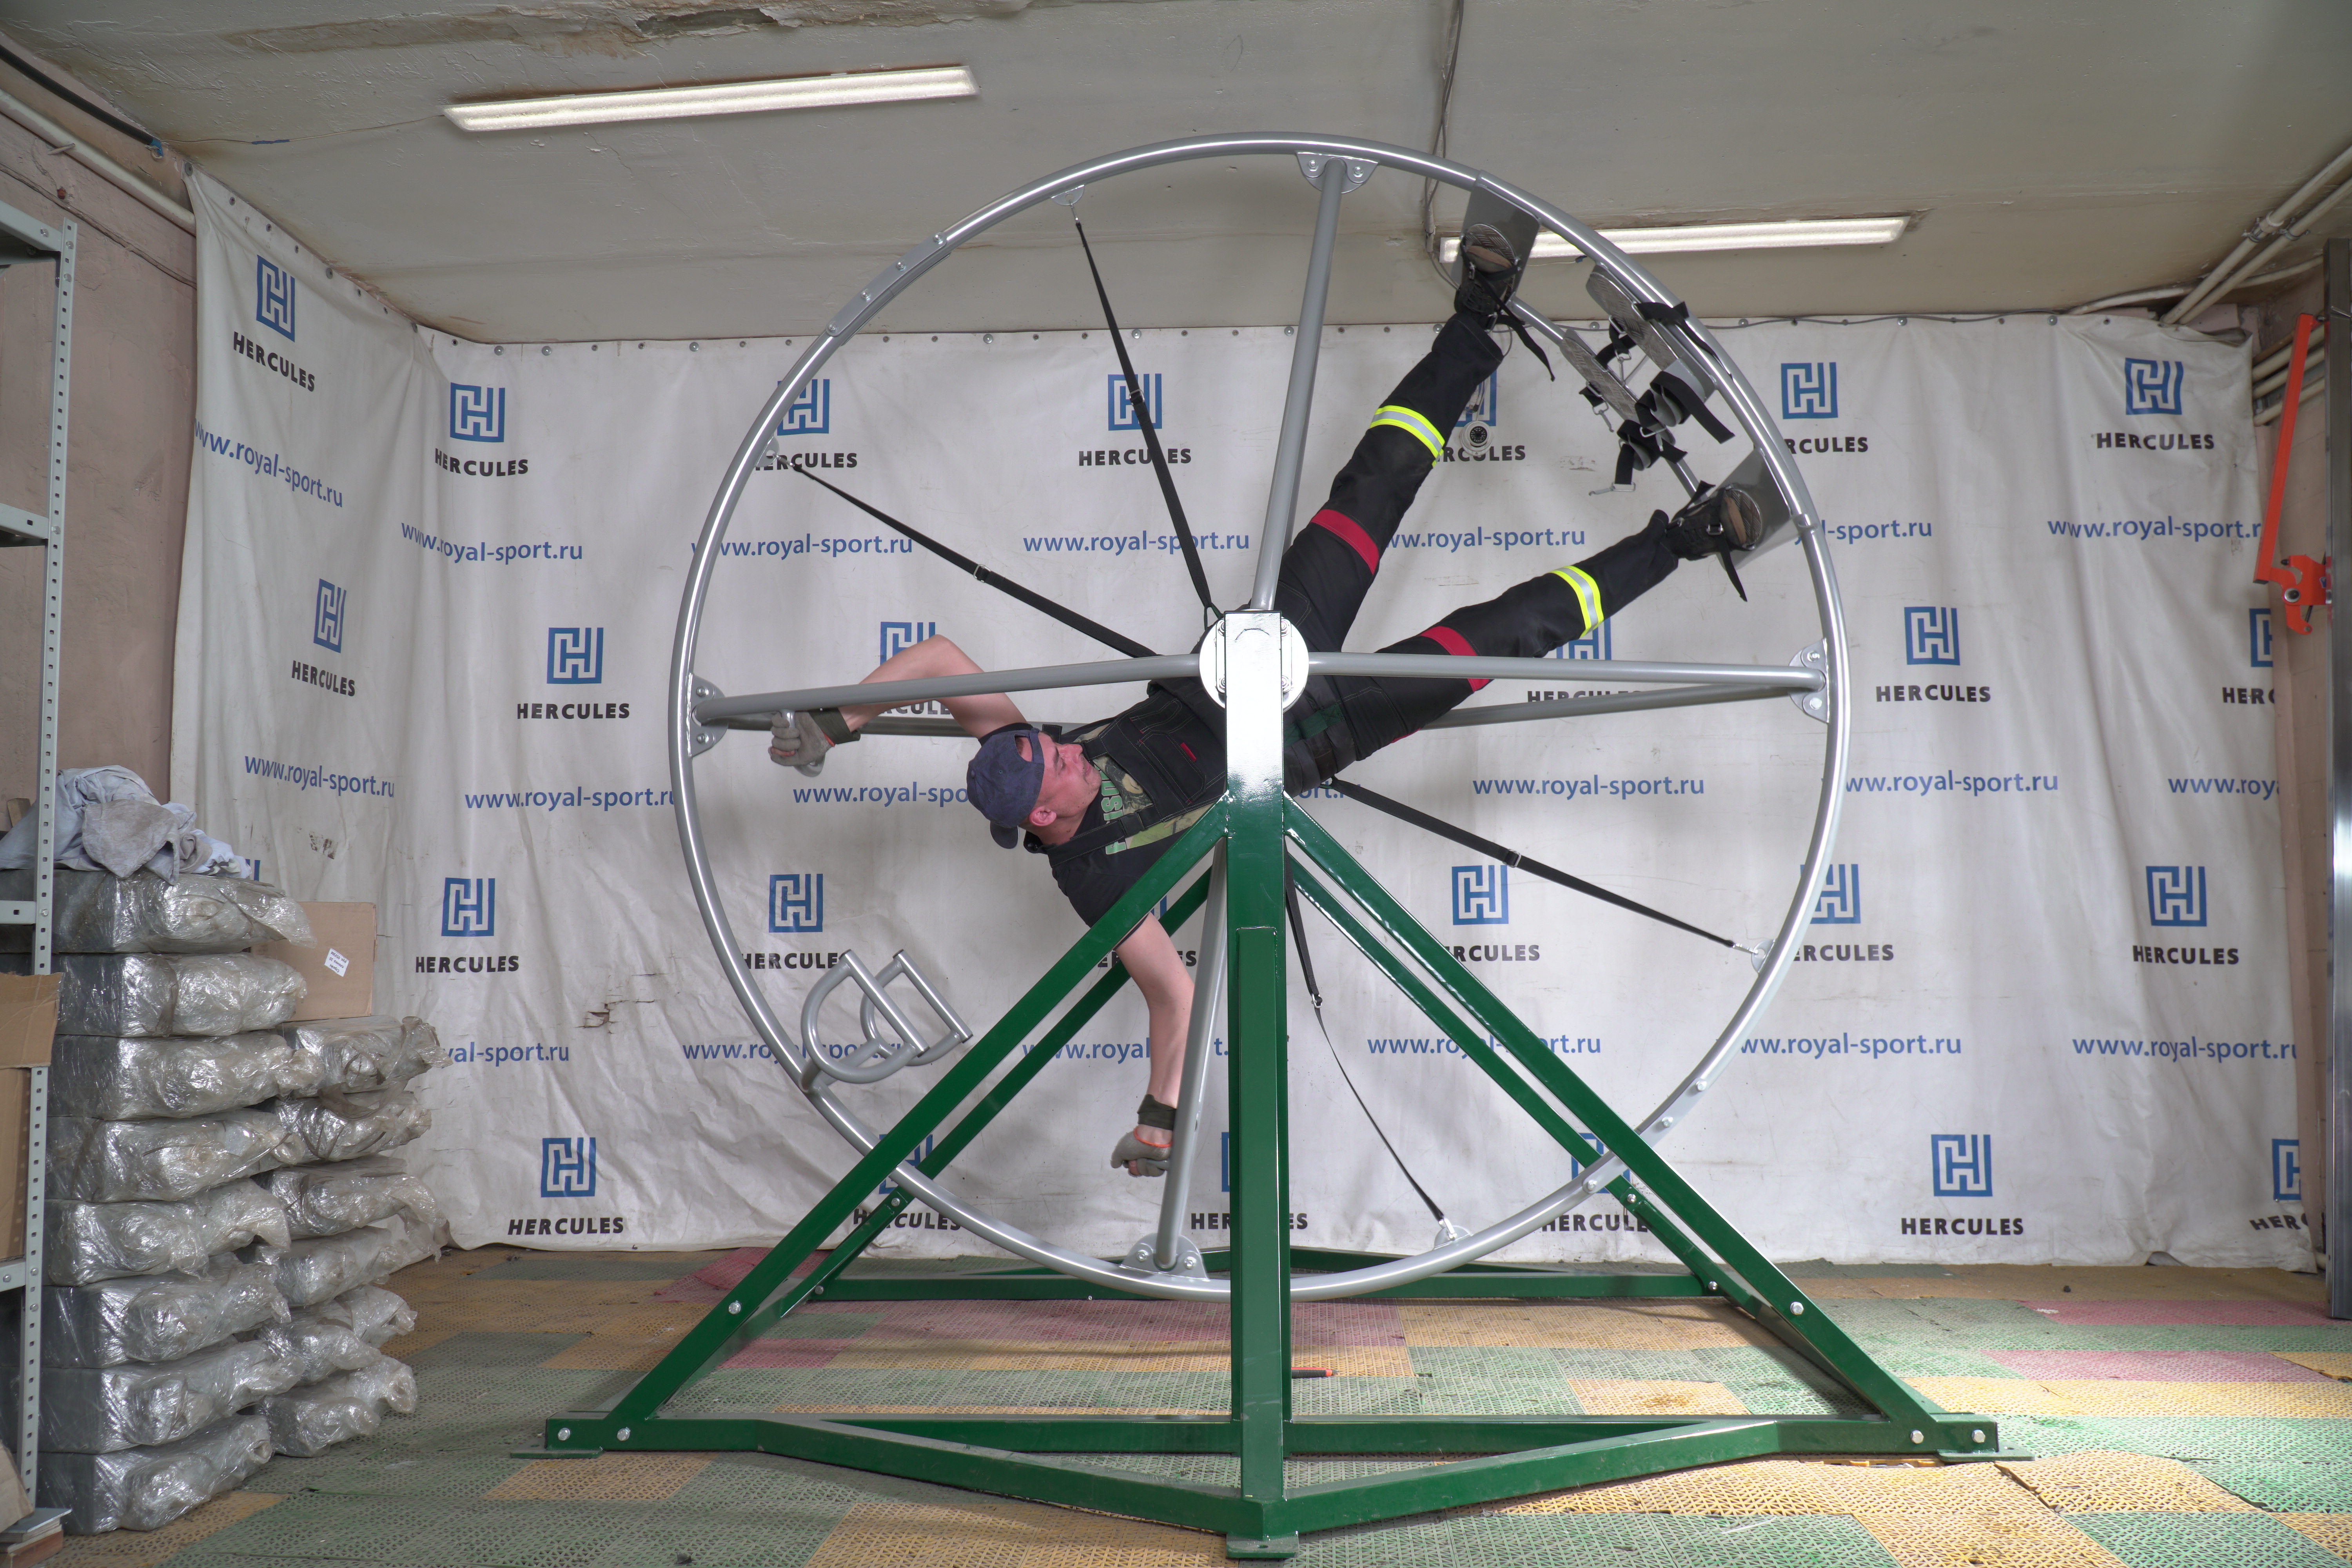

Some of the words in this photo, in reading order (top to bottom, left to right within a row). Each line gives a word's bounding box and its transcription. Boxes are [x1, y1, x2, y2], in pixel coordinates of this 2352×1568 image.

[233, 330, 315, 392] HERCULES
[1782, 437, 1868, 454] RCULES
[2096, 432, 2214, 450] HERCULES
[435, 447, 528, 477] HERCULES
[755, 453, 857, 470] RCULES
[1079, 448, 1191, 466] HERCUES
[2047, 515, 2261, 542] www.royal-sport.r
[401, 522, 583, 565] www.royal-sport.ru
[691, 534, 912, 560] ww.royal-sport.ru
[1387, 527, 1584, 554] ww.royal-sport.ru
[291, 660, 355, 697] HERCULES
[1876, 685, 1991, 702] HERCULES
[517, 703, 630, 719] HERCULES
[245, 755, 394, 798] www.royal-sport.ru
[1821, 770, 2058, 796] ww.royal-sport.ru
[793, 781, 969, 808] www.royal-spo
[1473, 775, 1704, 800] www.royal-sport.ru
[742, 953, 838, 969] HERCULE
[1443, 945, 1540, 962] RCULES
[1793, 945, 1894, 962] RCULES
[2132, 945, 2239, 965] HERCULES
[416, 956, 519, 973] HERCULES
[1716, 1033, 1962, 1059] ww.royal-sport.ru
[508, 1217, 624, 1235] HERCULES
[1542, 1214, 1648, 1232] HERCULE
[1901, 1218, 2024, 1235] HERCULES
